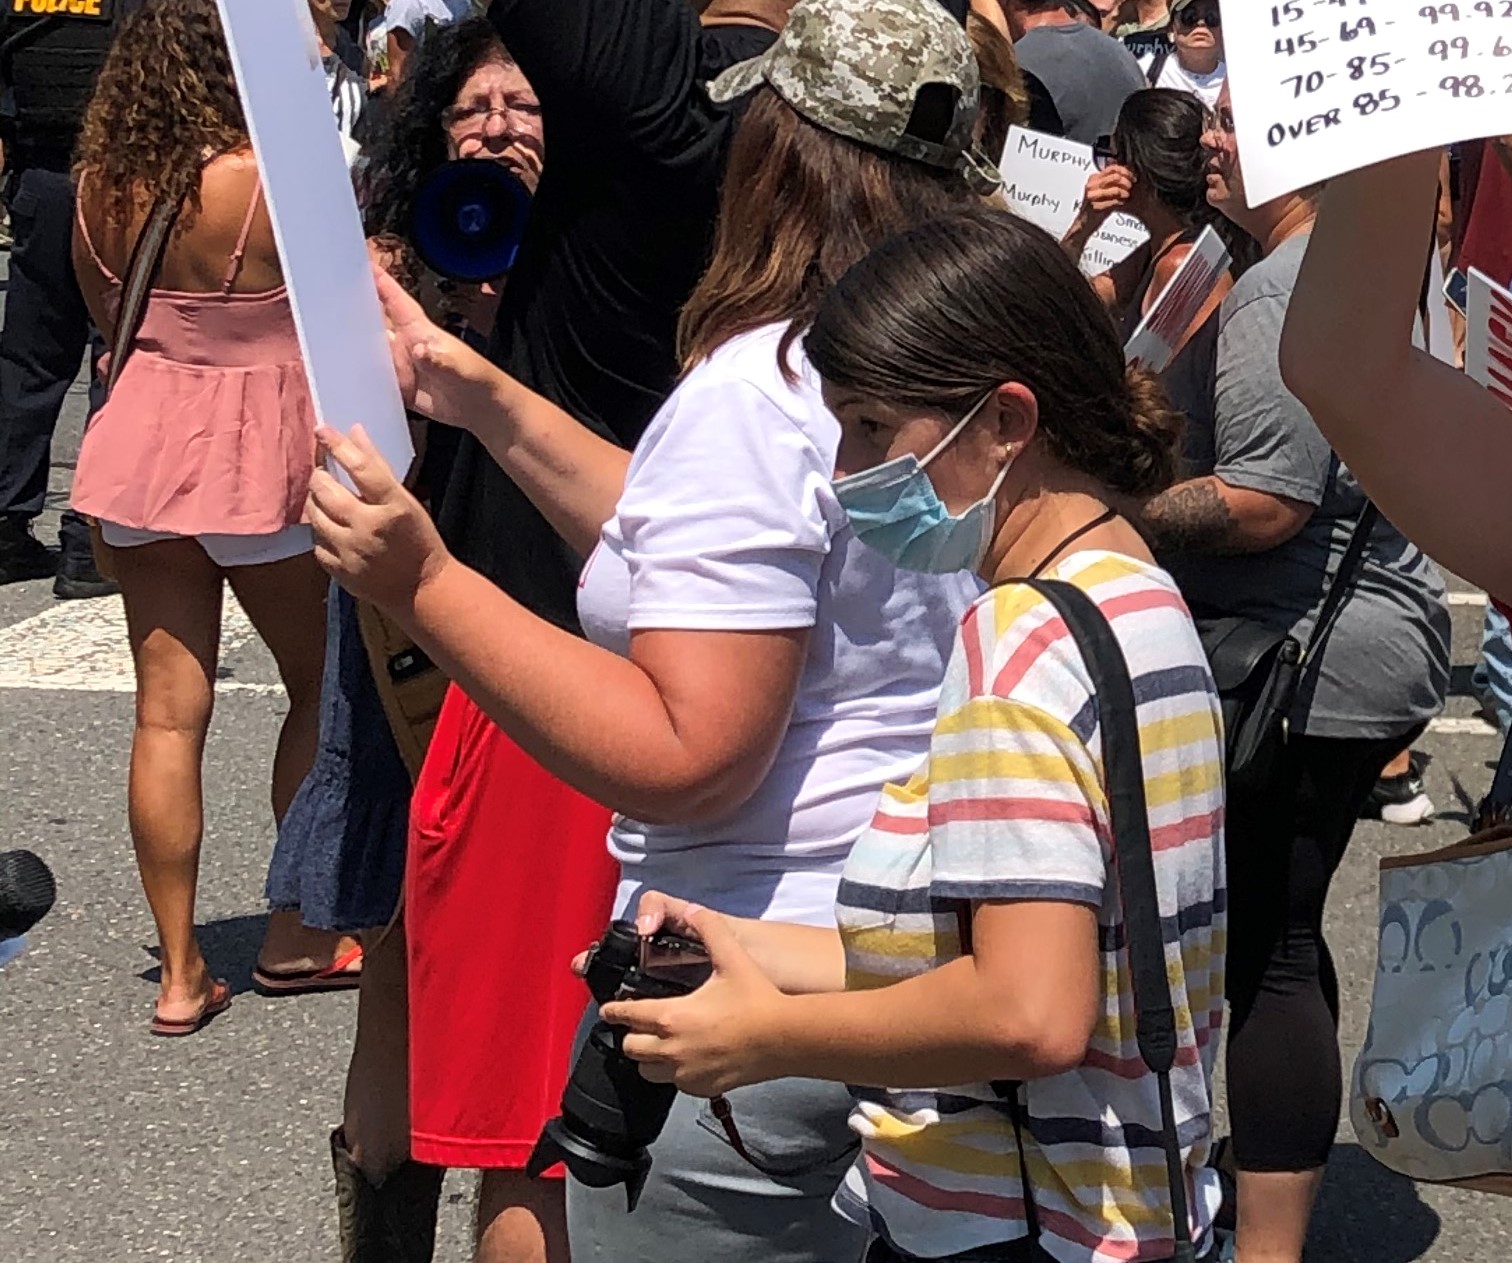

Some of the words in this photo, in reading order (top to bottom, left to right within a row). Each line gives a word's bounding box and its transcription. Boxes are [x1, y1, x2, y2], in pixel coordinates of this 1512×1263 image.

[1267, 107, 1342, 148] OVER
[1352, 87, 1401, 117] 85
[1001, 181, 1060, 214] Murphy
